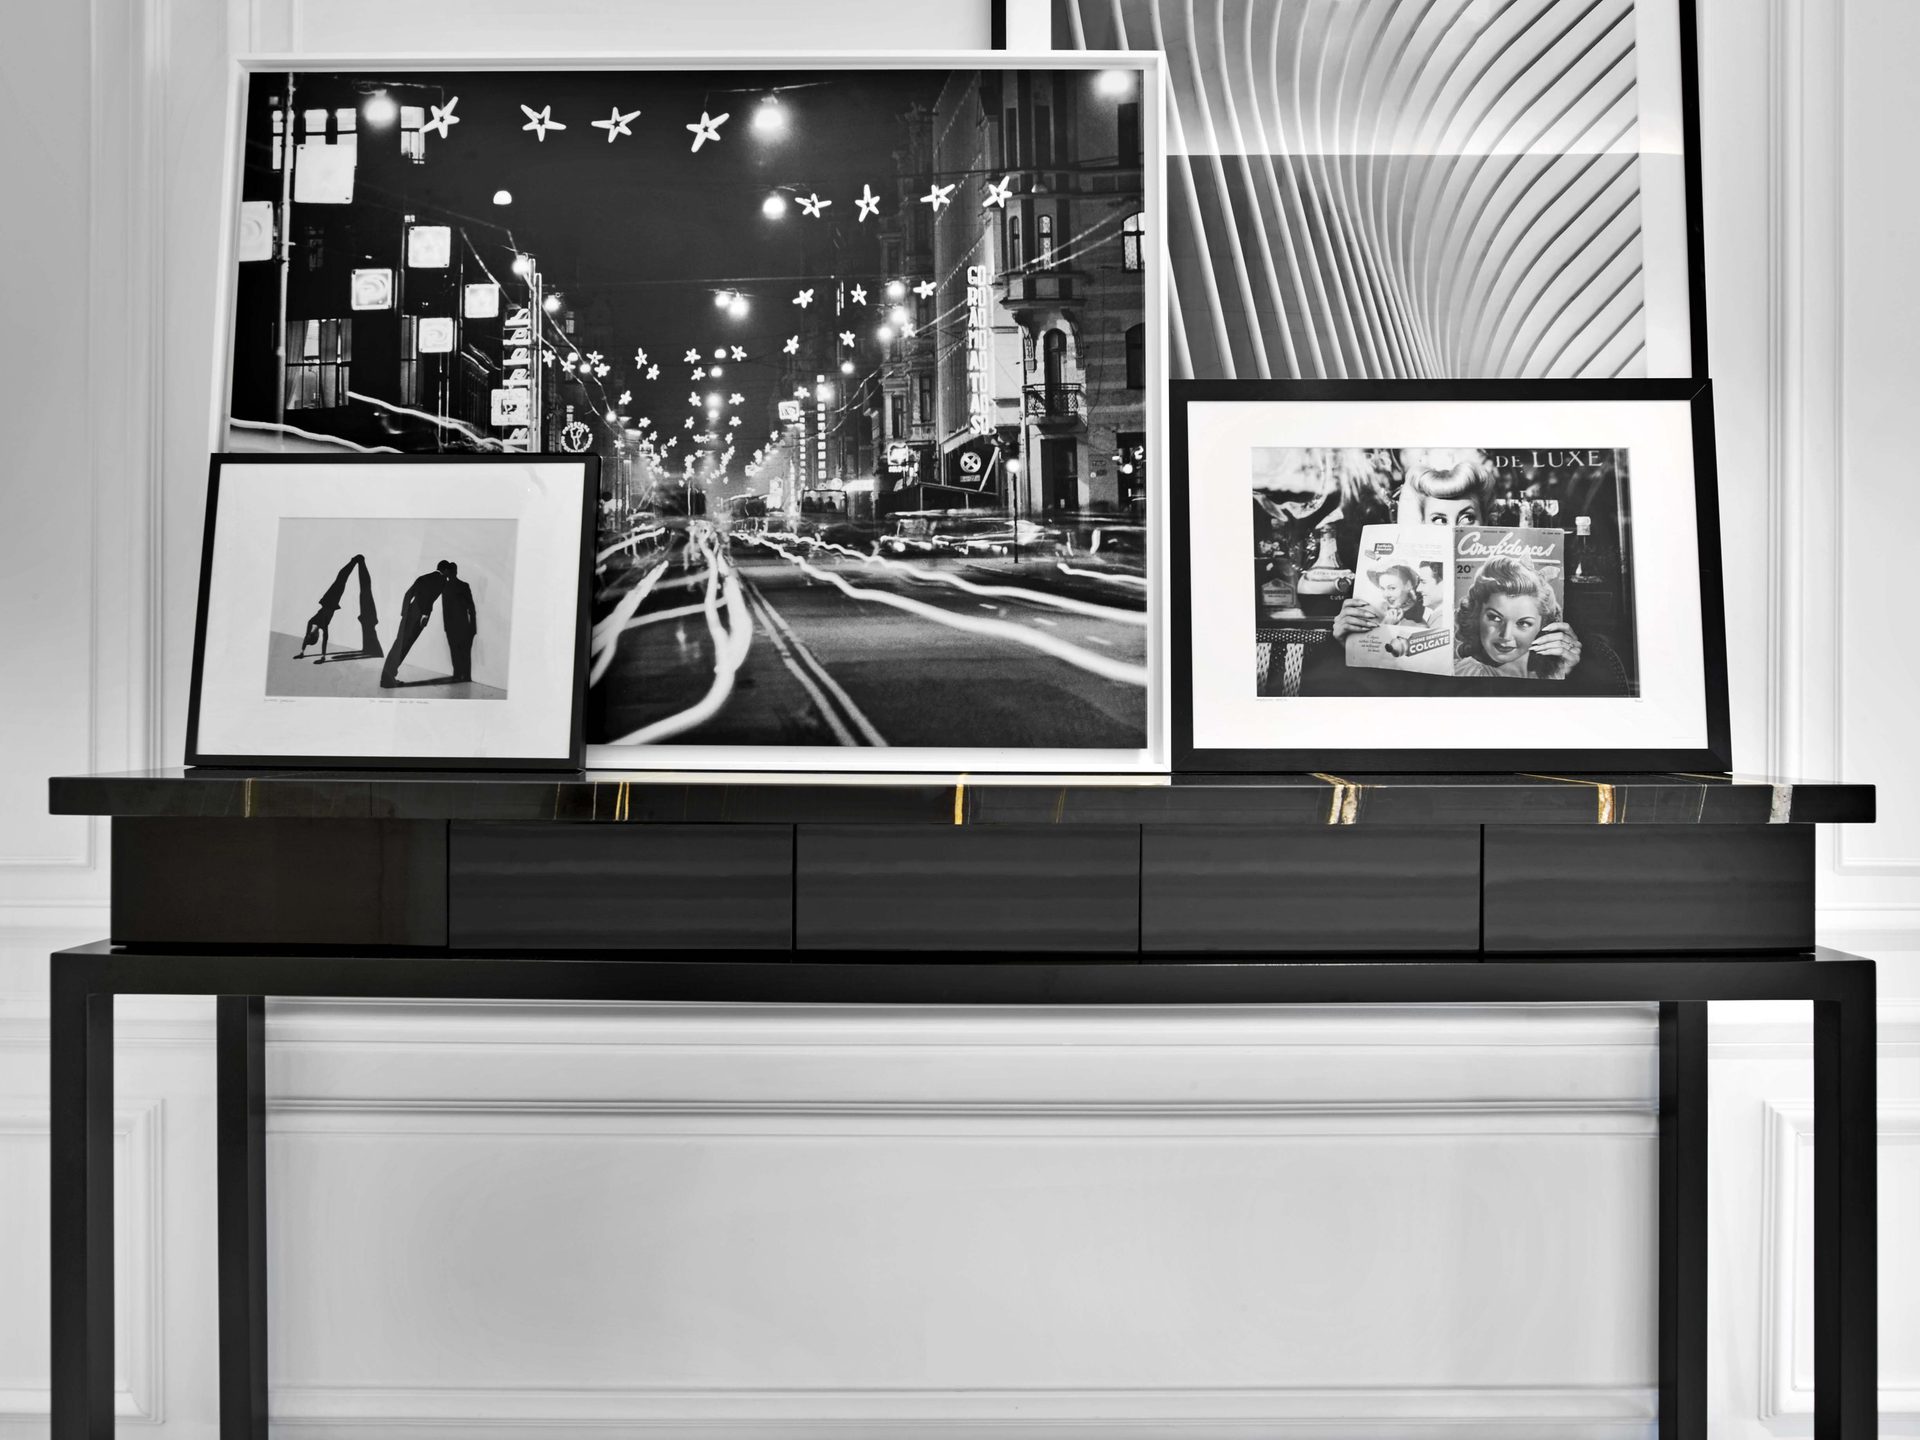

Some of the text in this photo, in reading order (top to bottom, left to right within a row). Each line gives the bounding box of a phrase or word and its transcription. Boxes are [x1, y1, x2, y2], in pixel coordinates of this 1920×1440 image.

[1496, 450, 1603, 468] DE LUXE
[1409, 636, 1449, 653] COLGATE
